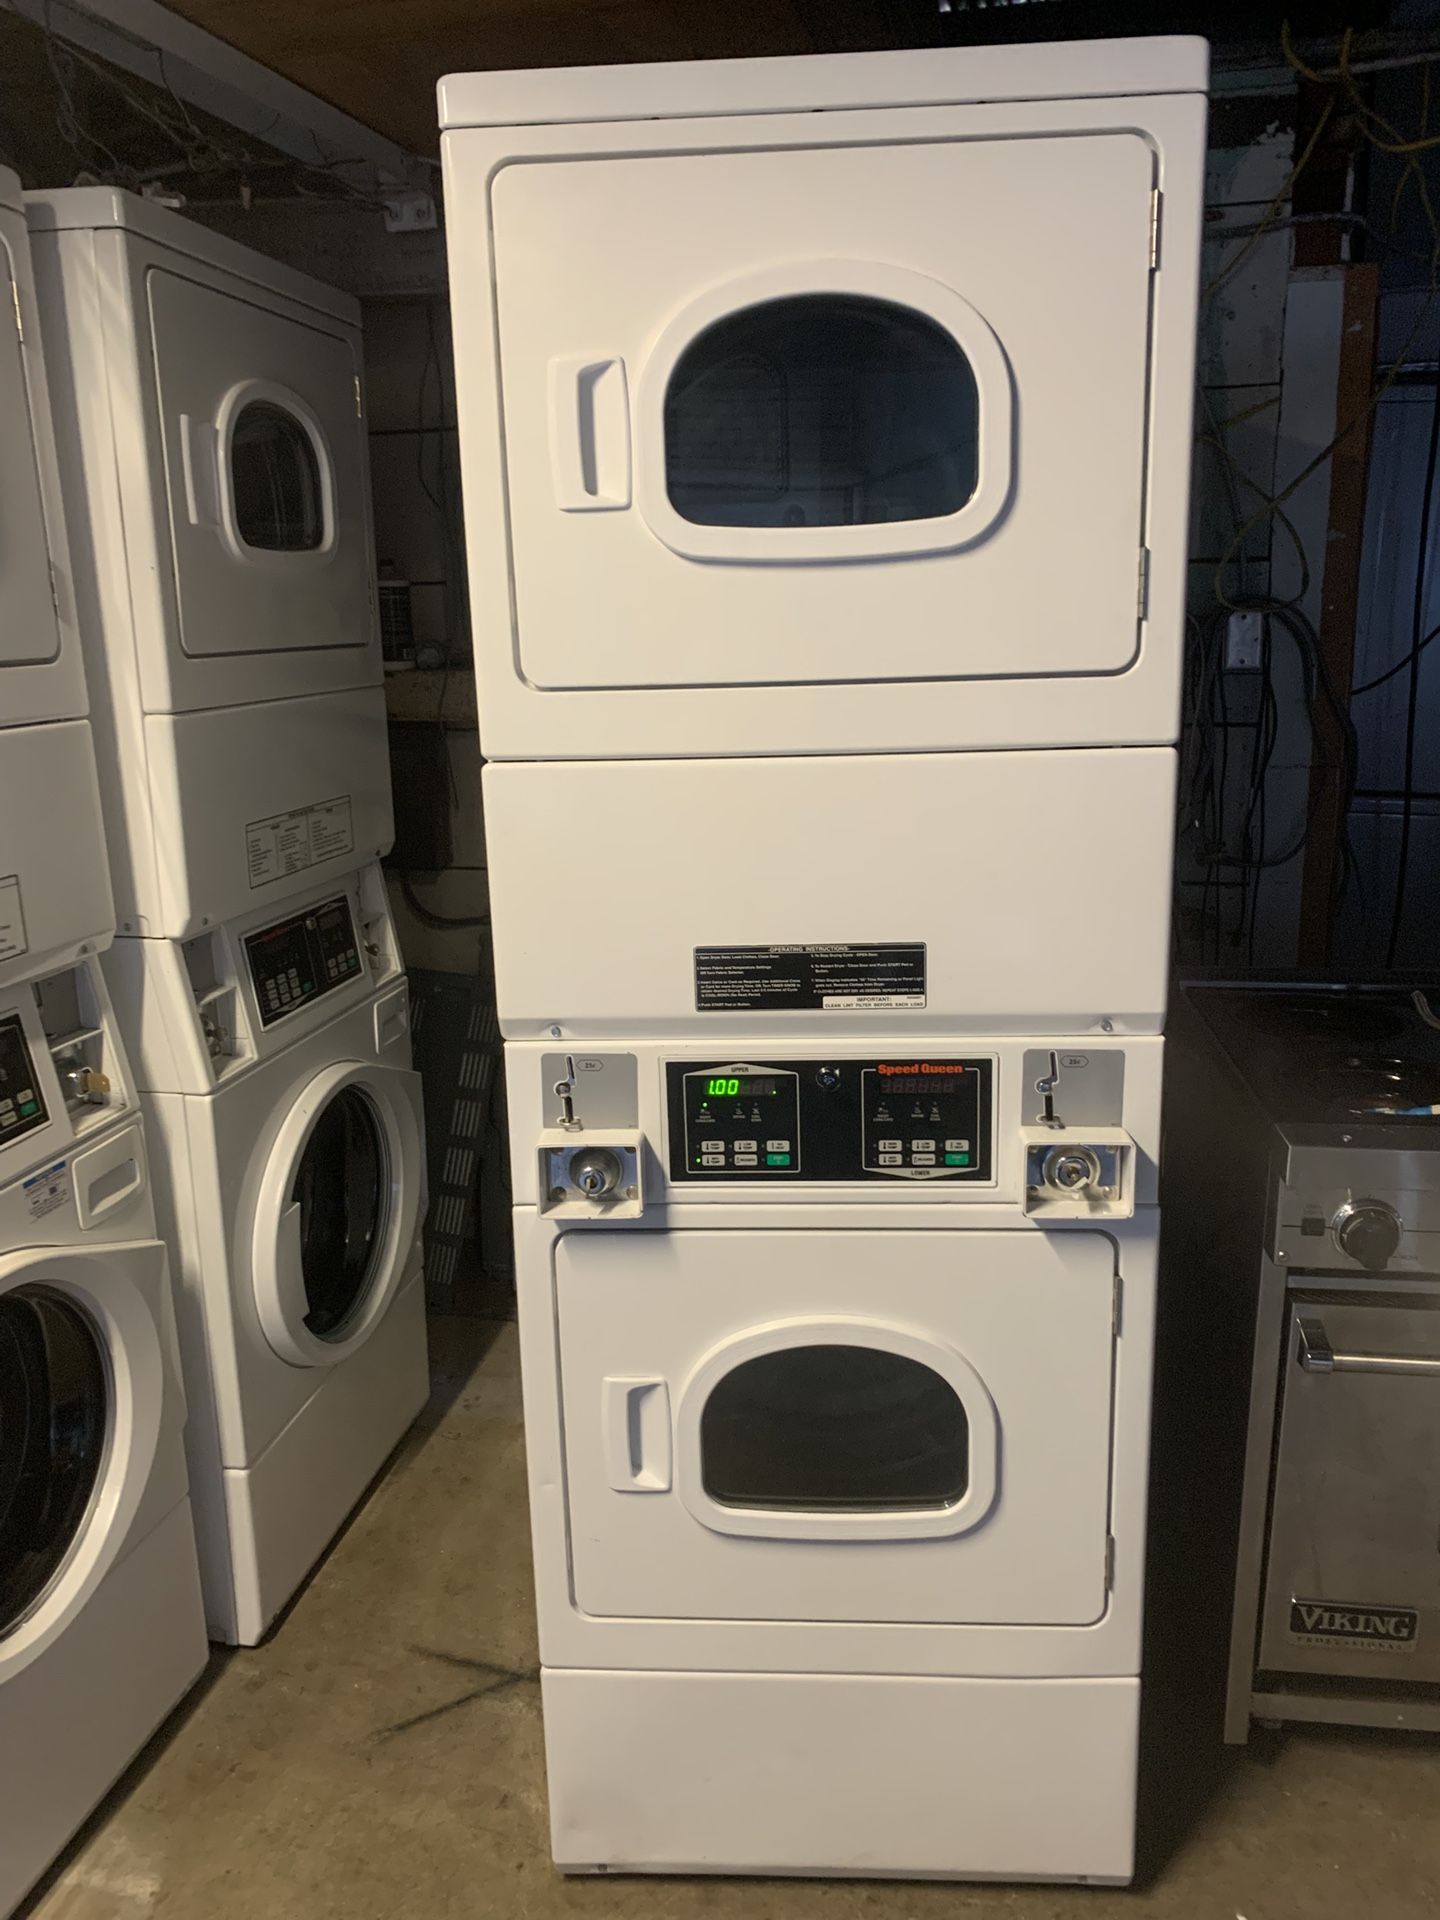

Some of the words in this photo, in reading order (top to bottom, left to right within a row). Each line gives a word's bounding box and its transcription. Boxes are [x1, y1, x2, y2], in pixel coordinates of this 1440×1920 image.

[878, 1063, 919, 1076] Speed
[921, 1063, 963, 1073] Queen
[1297, 1605, 1410, 1637] VIKING
